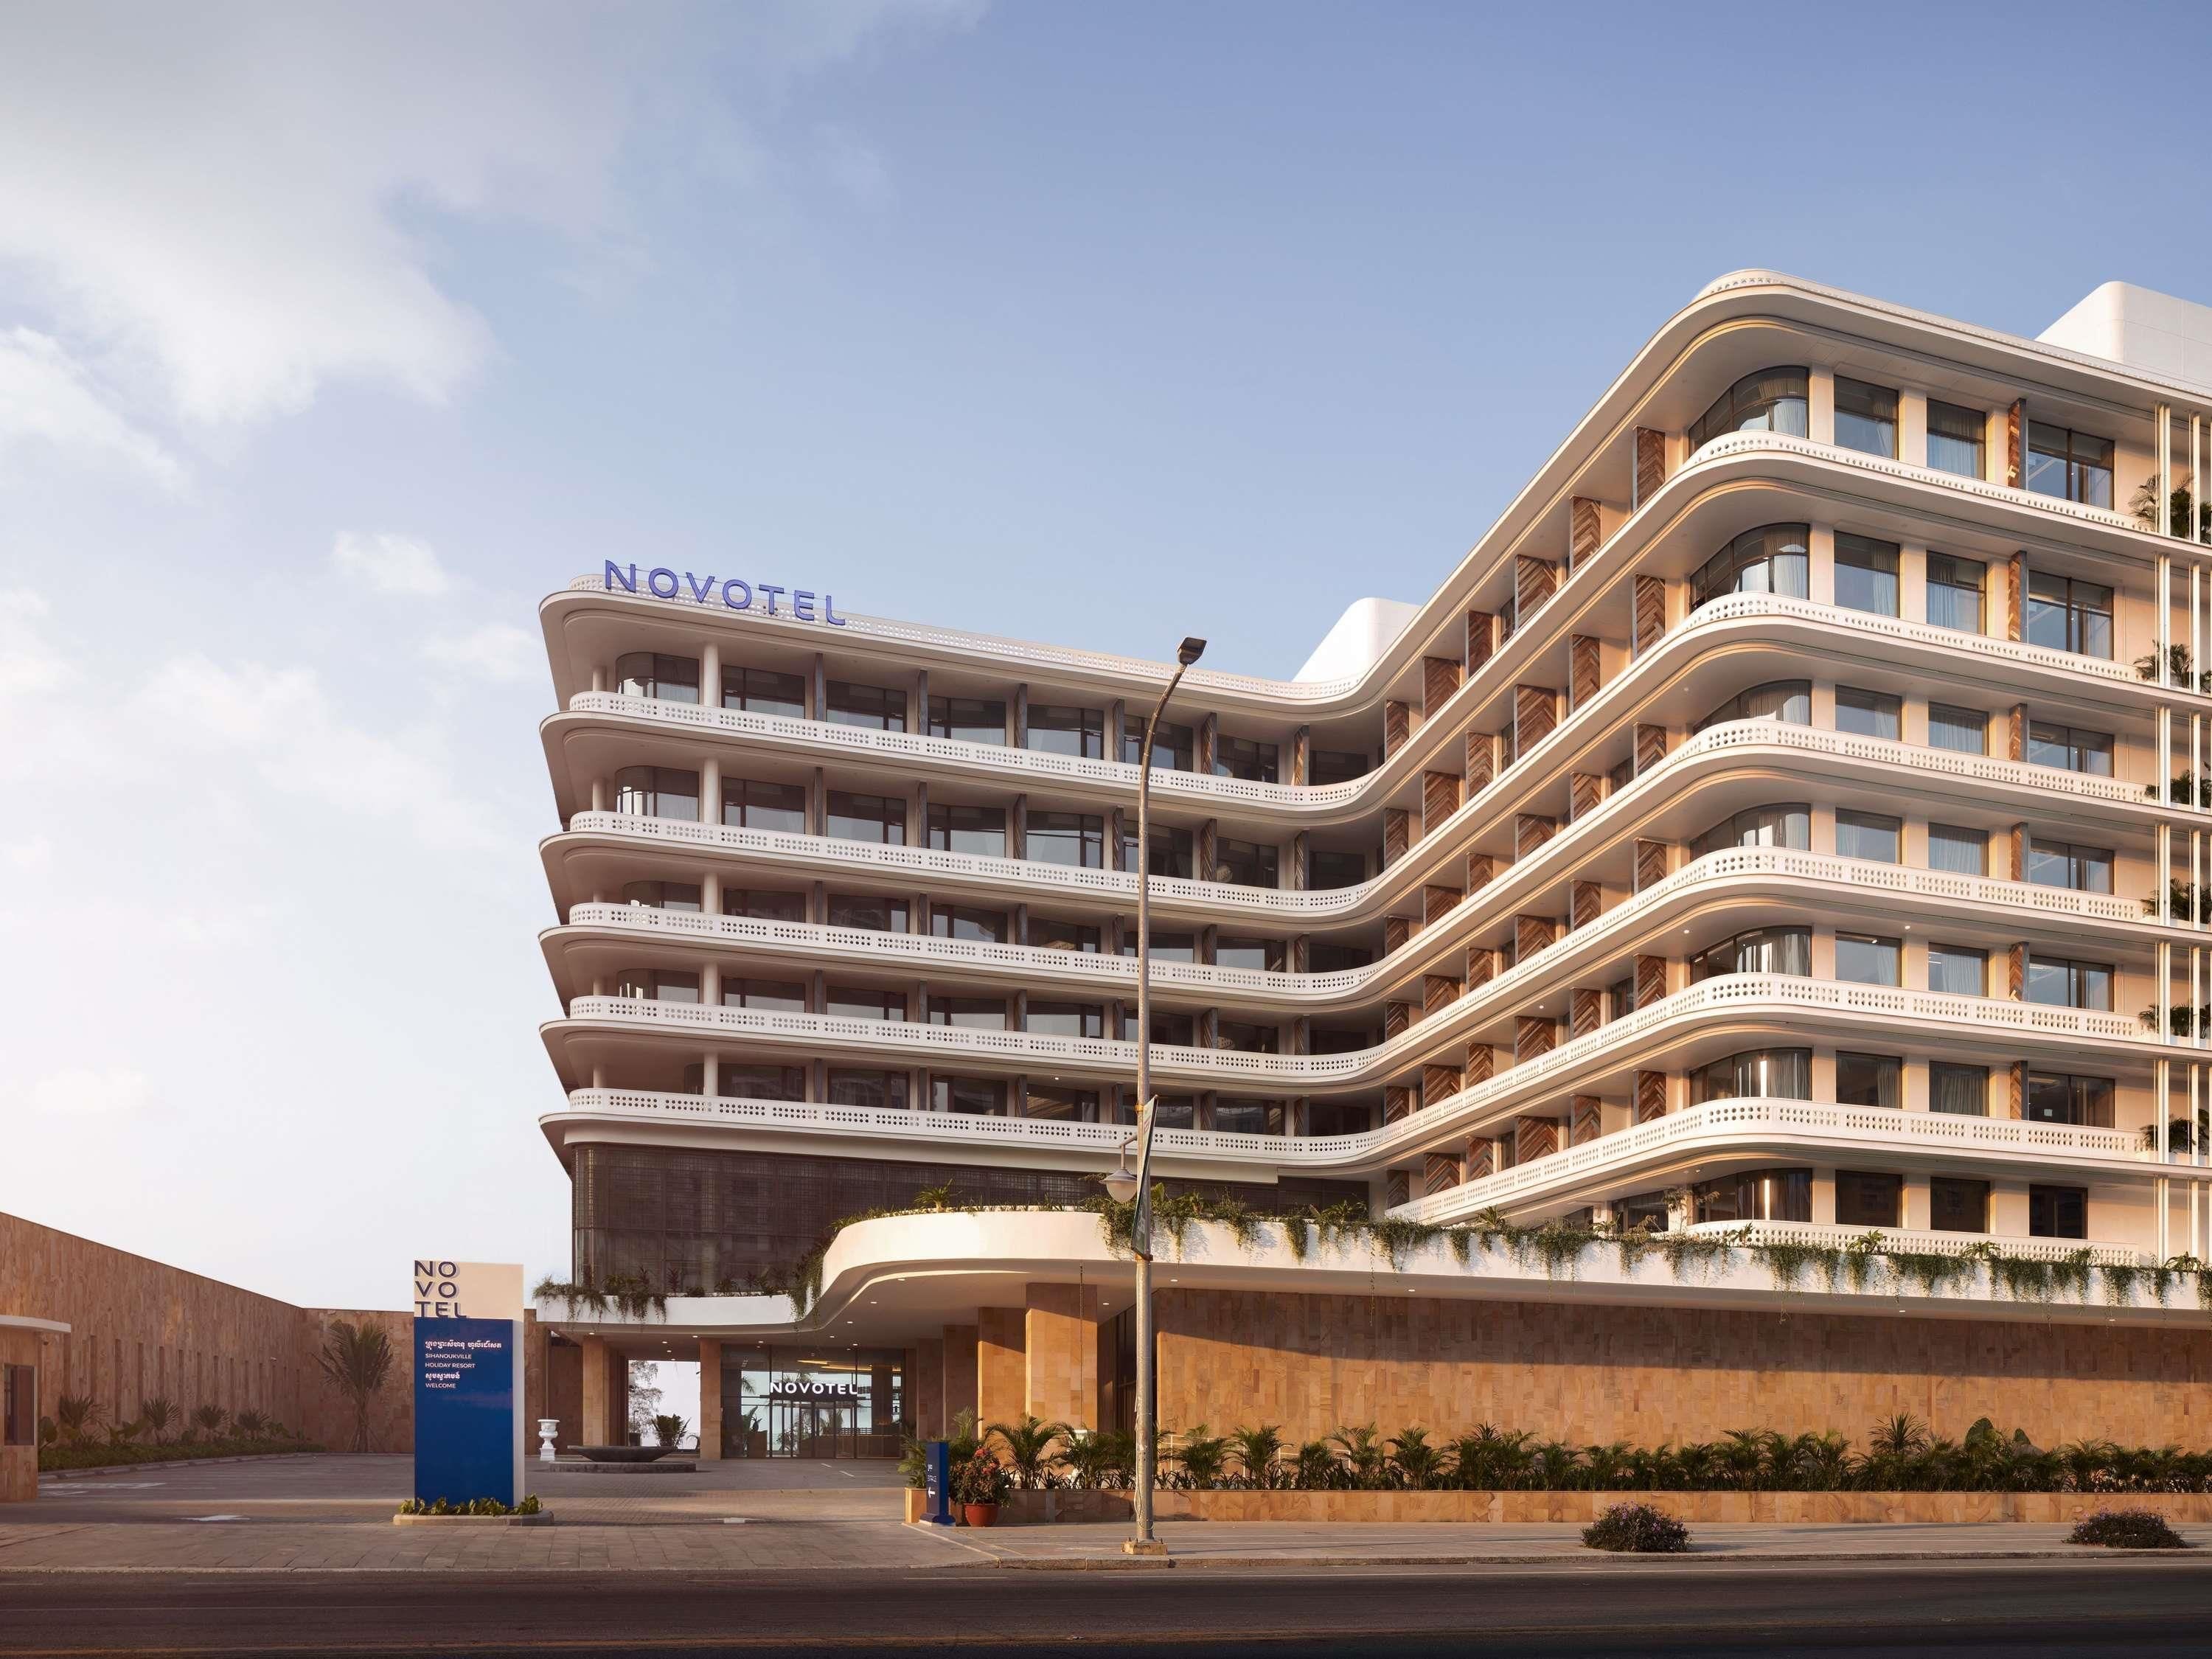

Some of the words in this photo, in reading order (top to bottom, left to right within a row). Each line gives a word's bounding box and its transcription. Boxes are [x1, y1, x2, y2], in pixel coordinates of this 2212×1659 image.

[605, 560, 846, 626] NOVOTEL
[414, 1260, 457, 1278] NO
[414, 1281, 457, 1298] VO
[414, 1301, 467, 1318] TEL
[770, 1382, 858, 1395] NOVOTEL
